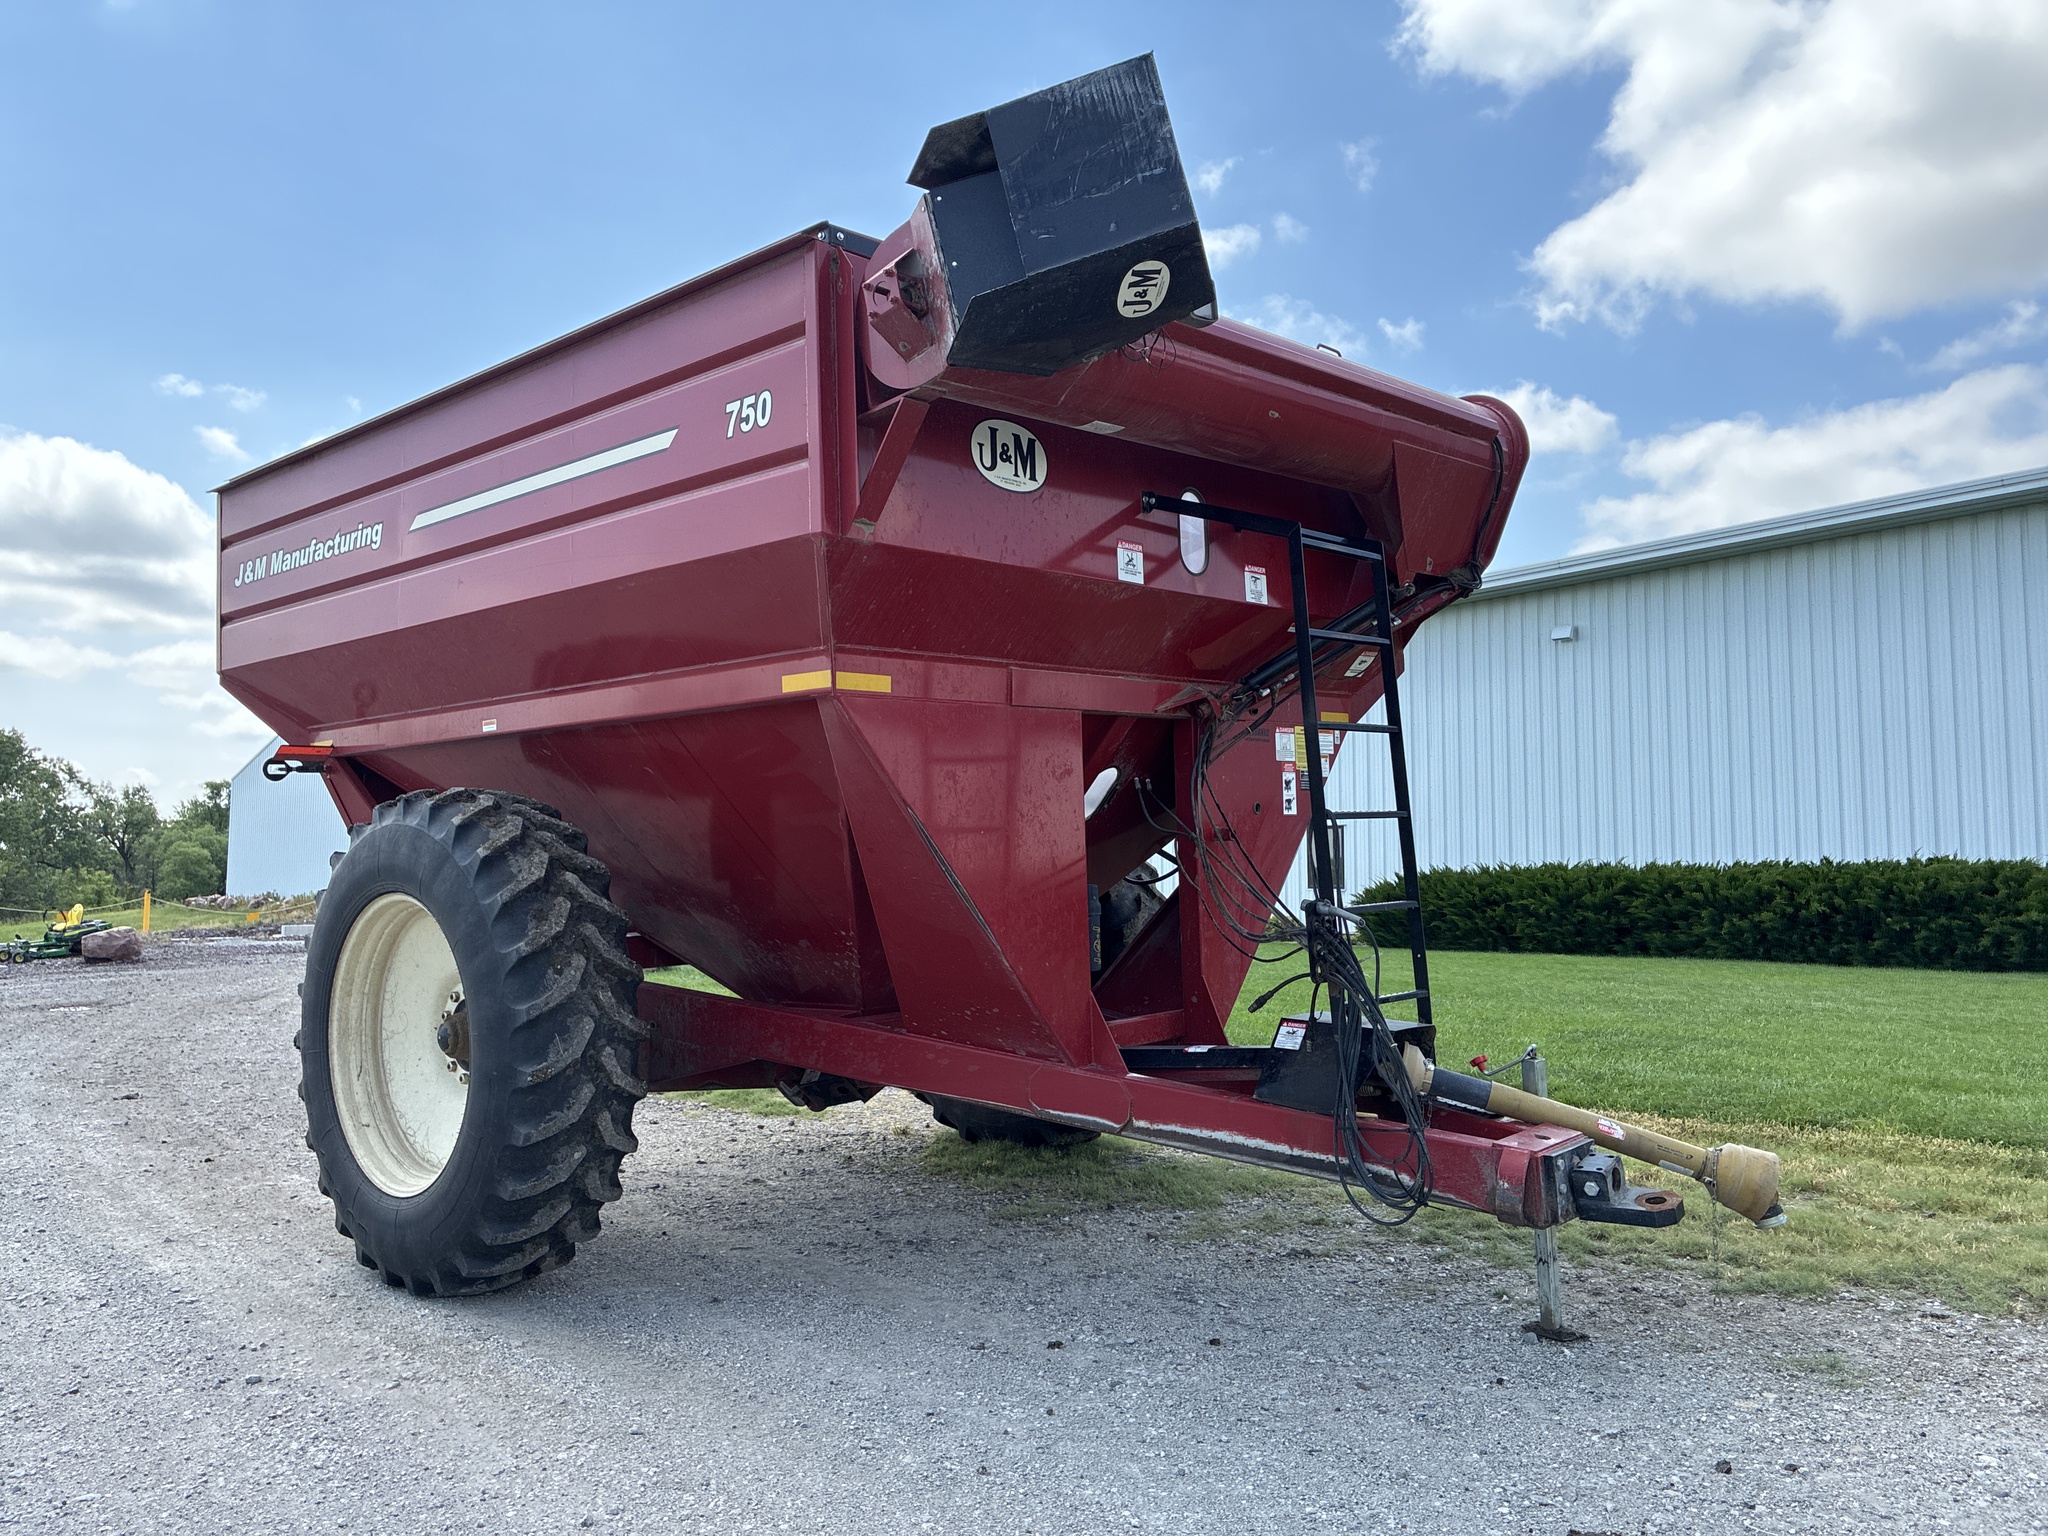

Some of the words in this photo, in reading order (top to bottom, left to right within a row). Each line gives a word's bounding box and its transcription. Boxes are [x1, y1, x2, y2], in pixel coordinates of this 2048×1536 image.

[1123, 268, 1162, 314] J&M
[725, 389, 772, 439] 750
[977, 426, 1039, 482] J&M
[234, 553, 268, 587] J&M
[270, 520, 384, 576] Manufacturing
[1122, 541, 1143, 552] DANGER
